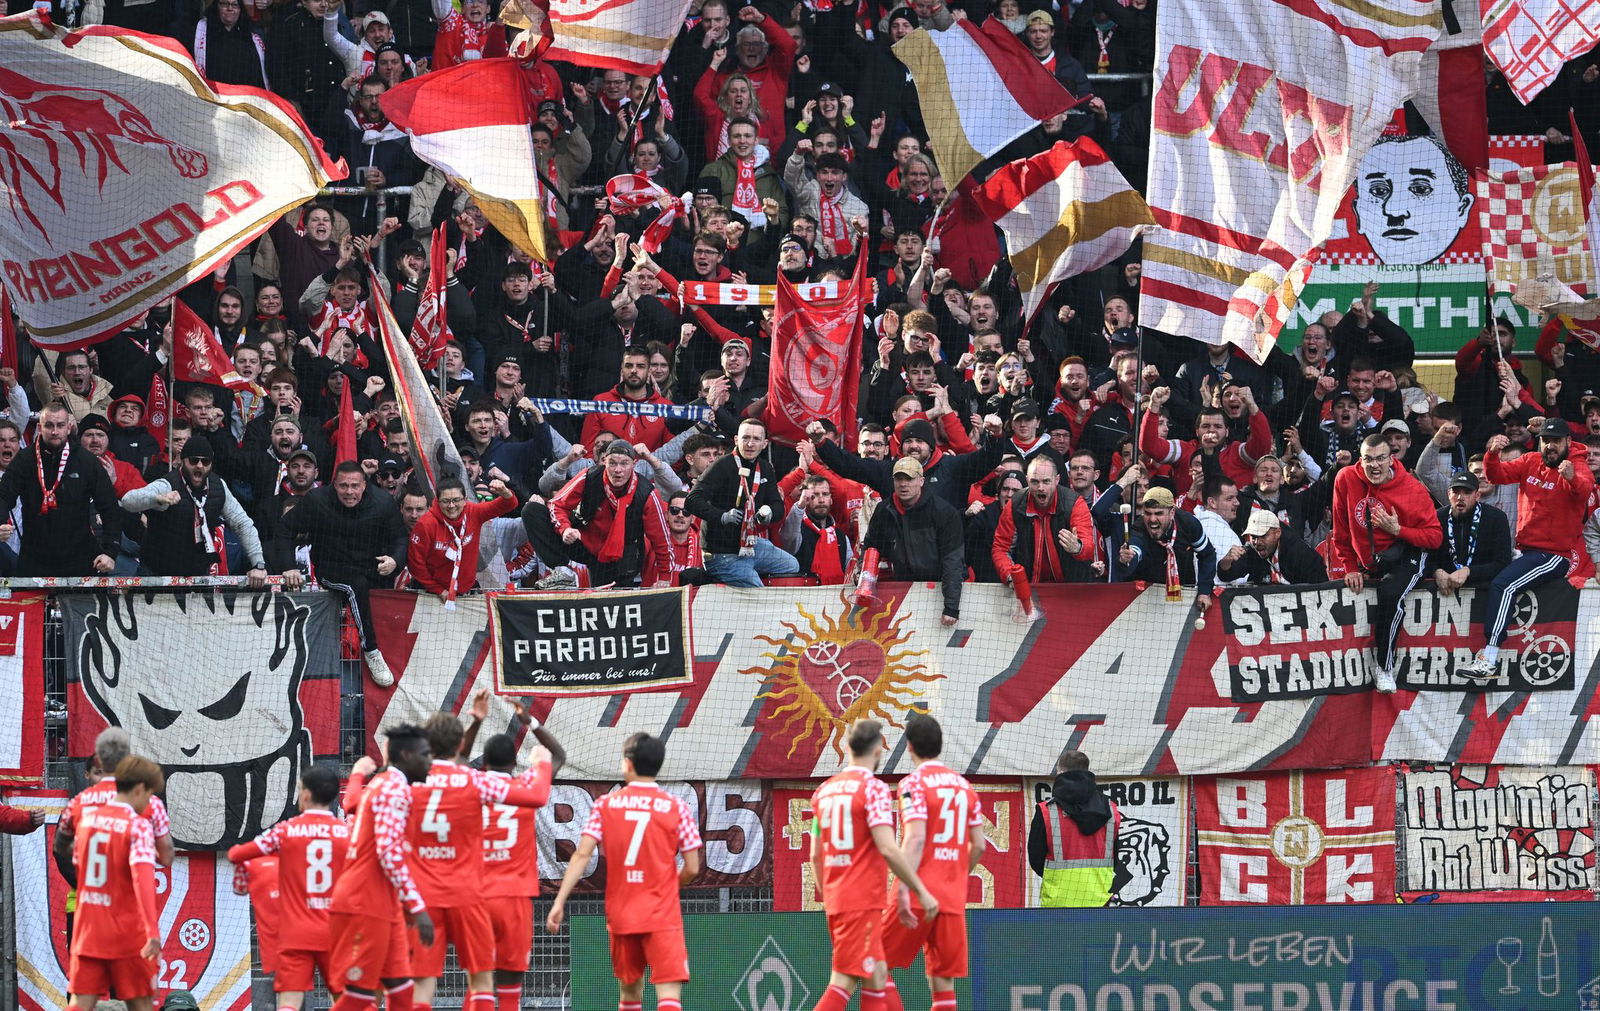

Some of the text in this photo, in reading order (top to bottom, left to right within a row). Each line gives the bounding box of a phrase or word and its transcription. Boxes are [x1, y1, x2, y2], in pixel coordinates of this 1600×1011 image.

[3, 180, 266, 304] RHEINGOLD
[99, 271, 156, 304] MAINZ
[1526, 475, 1555, 490] ULTAS
[536, 603, 642, 633] CURVA
[1229, 586, 1476, 646] SEKTON
[513, 631, 670, 663] PARADISO
[531, 663, 657, 684] Für immer bei uns!
[421, 790, 450, 842] 4
[608, 797, 650, 809] MAINZ
[932, 788, 968, 845] 31
[1404, 770, 1591, 842] Moguntia
[287, 824, 330, 837] MAINZ
[624, 811, 651, 866] 7
[85, 832, 111, 888] 6
[305, 839, 333, 893] 8
[419, 846, 456, 860] POSCH
[627, 870, 645, 883] LEE
[1111, 928, 1355, 974] WIR LEBEN
[1009, 979, 1459, 1011] FOODSERVICE
